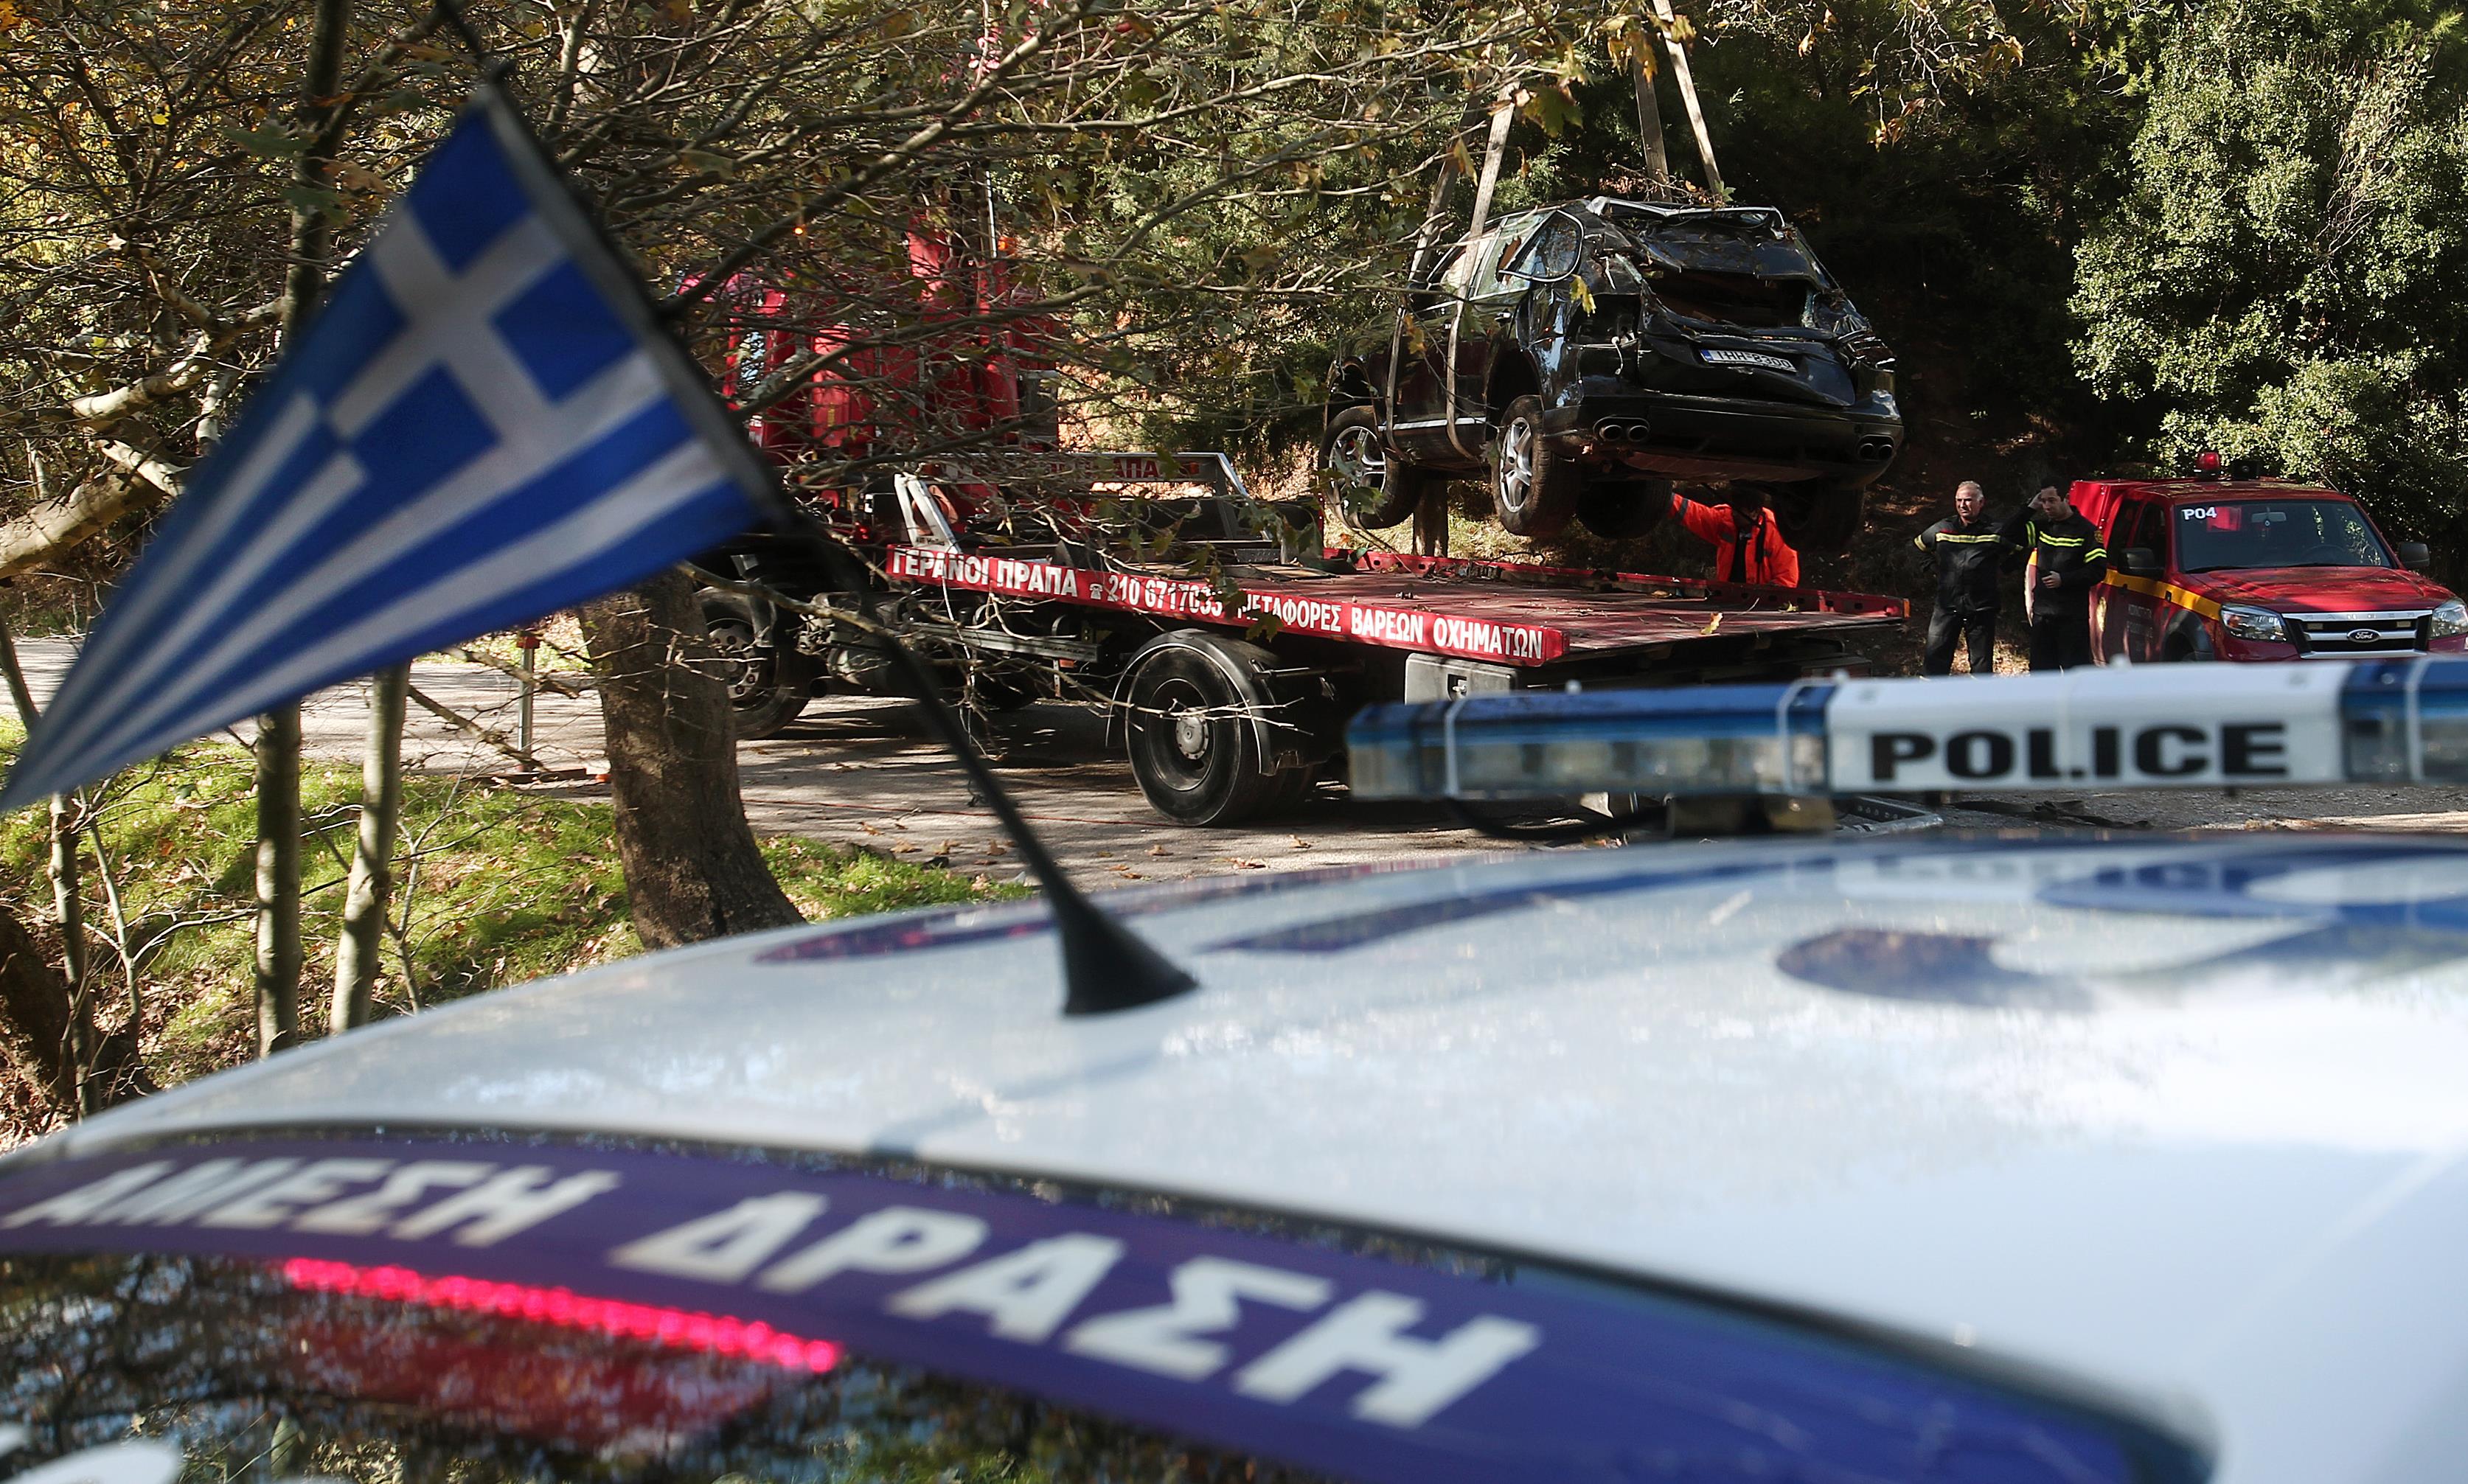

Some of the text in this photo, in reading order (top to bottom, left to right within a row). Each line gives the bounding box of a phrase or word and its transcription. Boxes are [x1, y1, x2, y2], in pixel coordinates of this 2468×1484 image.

[892, 548, 990, 585] ΓΕΡΑΝΟΙ
[996, 559, 1078, 597] ΠΡΑΠΑ
[1107, 574, 1141, 606] 210
[1350, 606, 1424, 644] ΒΑΡΕΩΝ
[1433, 617, 1543, 659] ΟΧΗΜΑΤΩΝ
[1870, 721, 2287, 781] POLICE
[1, 1156, 1543, 1430] ΑΜΕΣΗ ΔΡΑΣΗ
